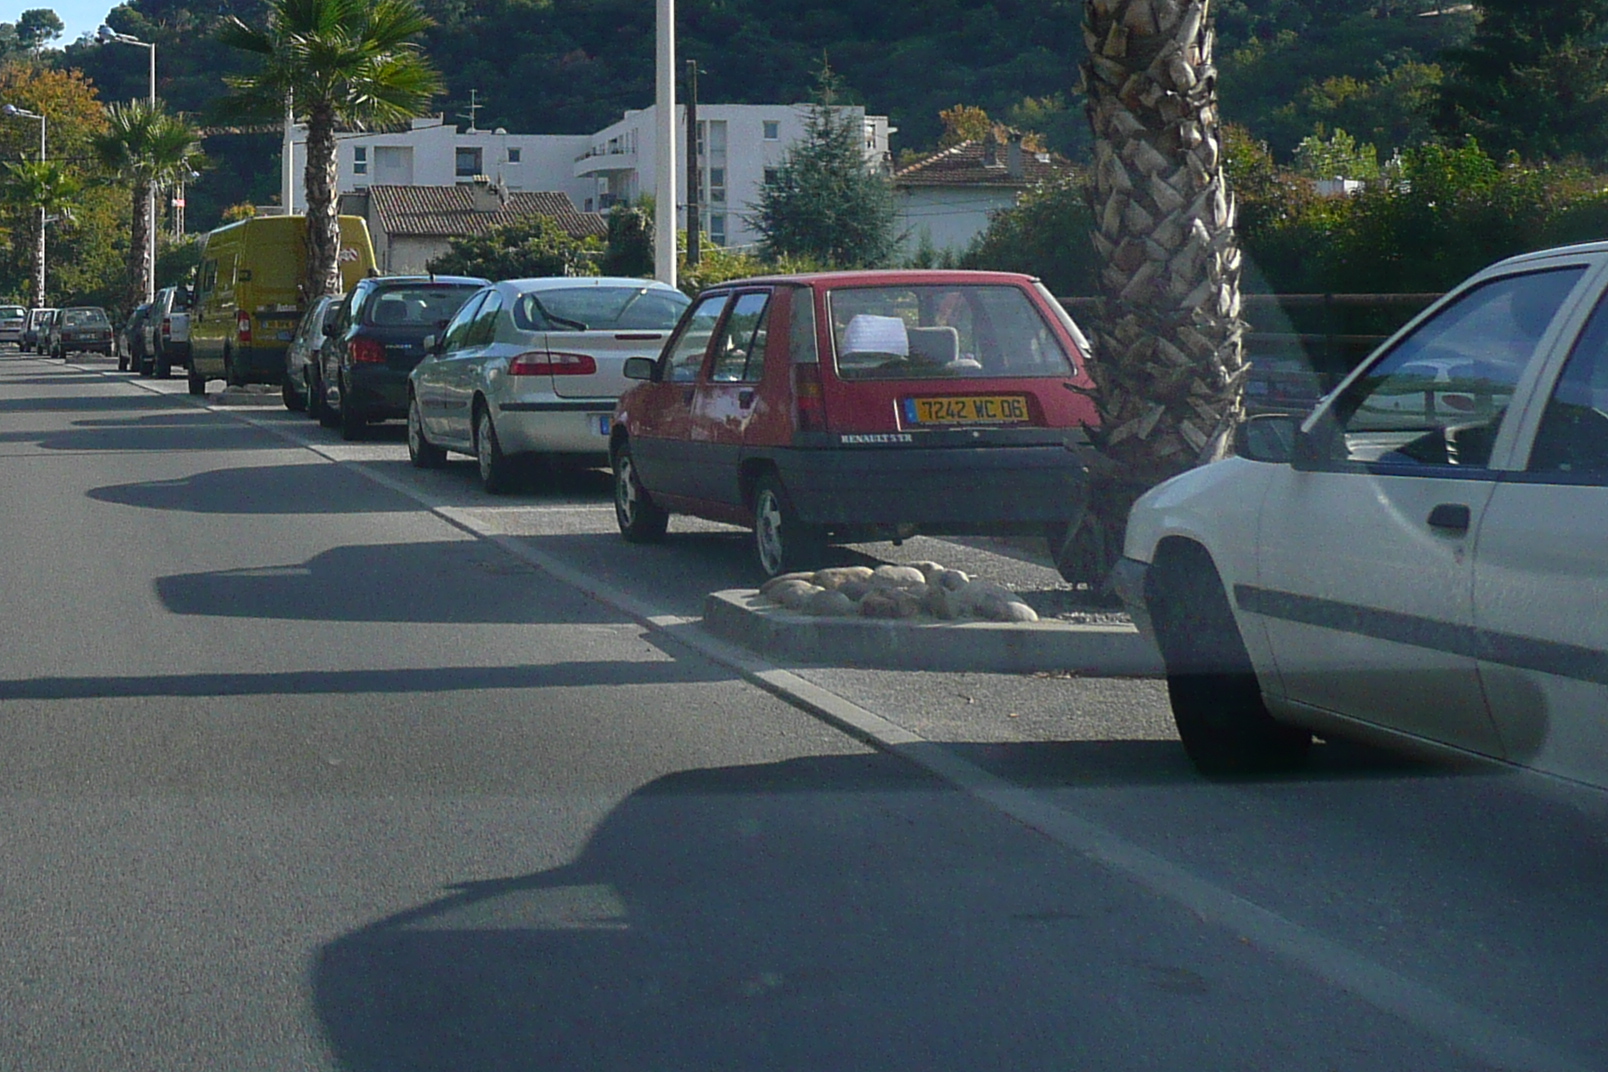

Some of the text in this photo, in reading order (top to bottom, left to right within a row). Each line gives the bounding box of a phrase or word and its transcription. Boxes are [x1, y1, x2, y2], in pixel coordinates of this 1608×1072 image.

[921, 399, 1023, 419] 7242 WC 06
[841, 434, 889, 443] RENAULT
